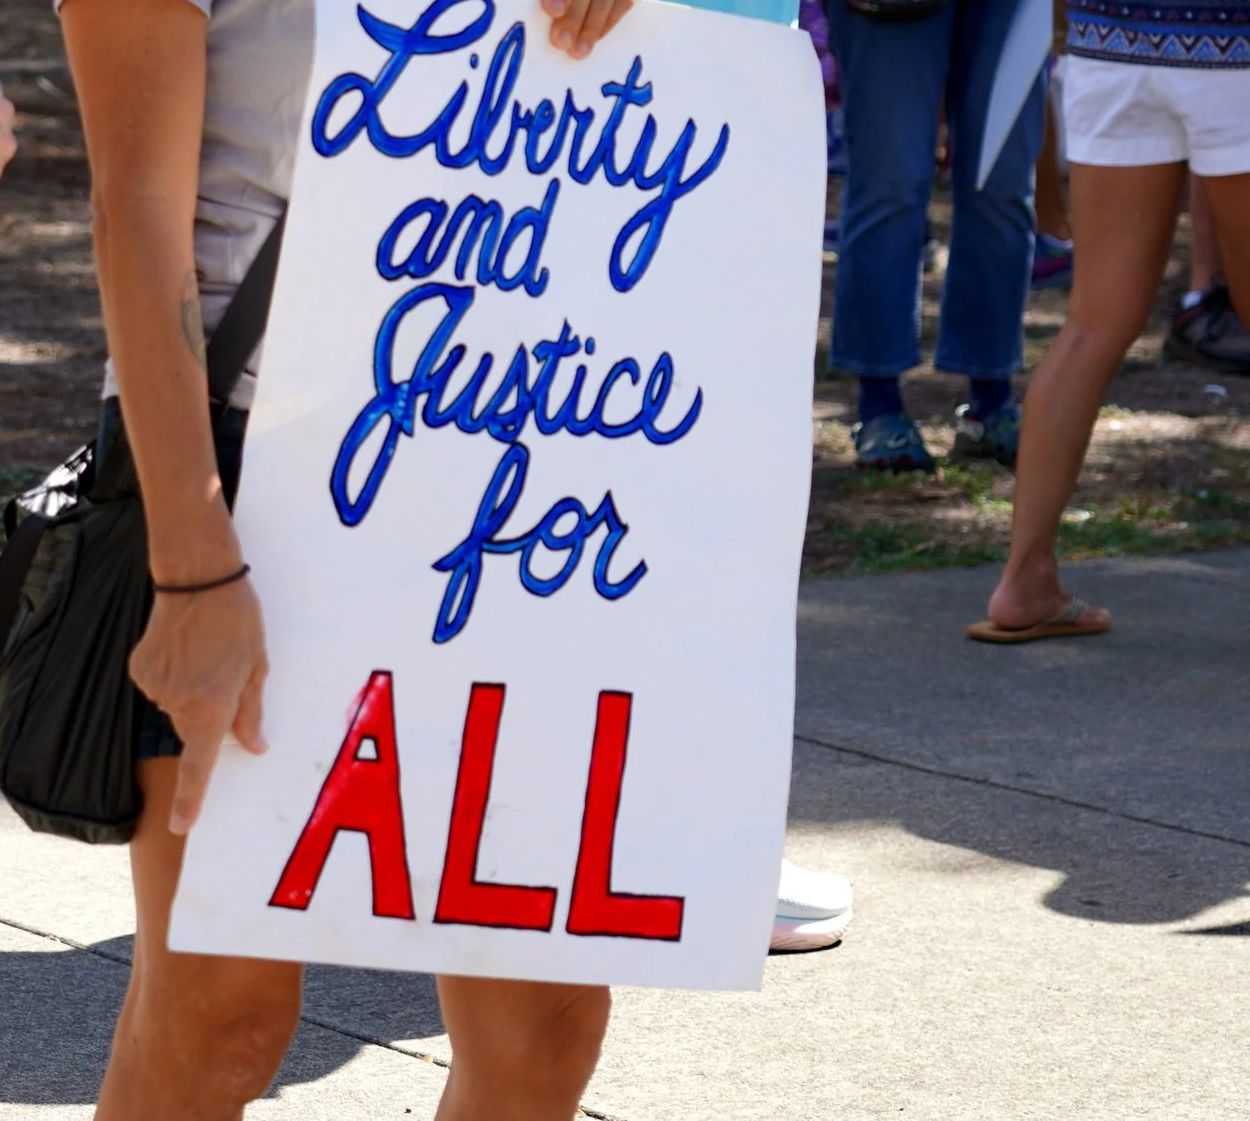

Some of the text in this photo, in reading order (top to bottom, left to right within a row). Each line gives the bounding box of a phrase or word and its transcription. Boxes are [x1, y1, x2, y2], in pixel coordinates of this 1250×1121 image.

[375, 177, 560, 298] and
[329, 281, 704, 528] Justice
[432, 440, 649, 645] for
[267, 670, 685, 943] ALL
